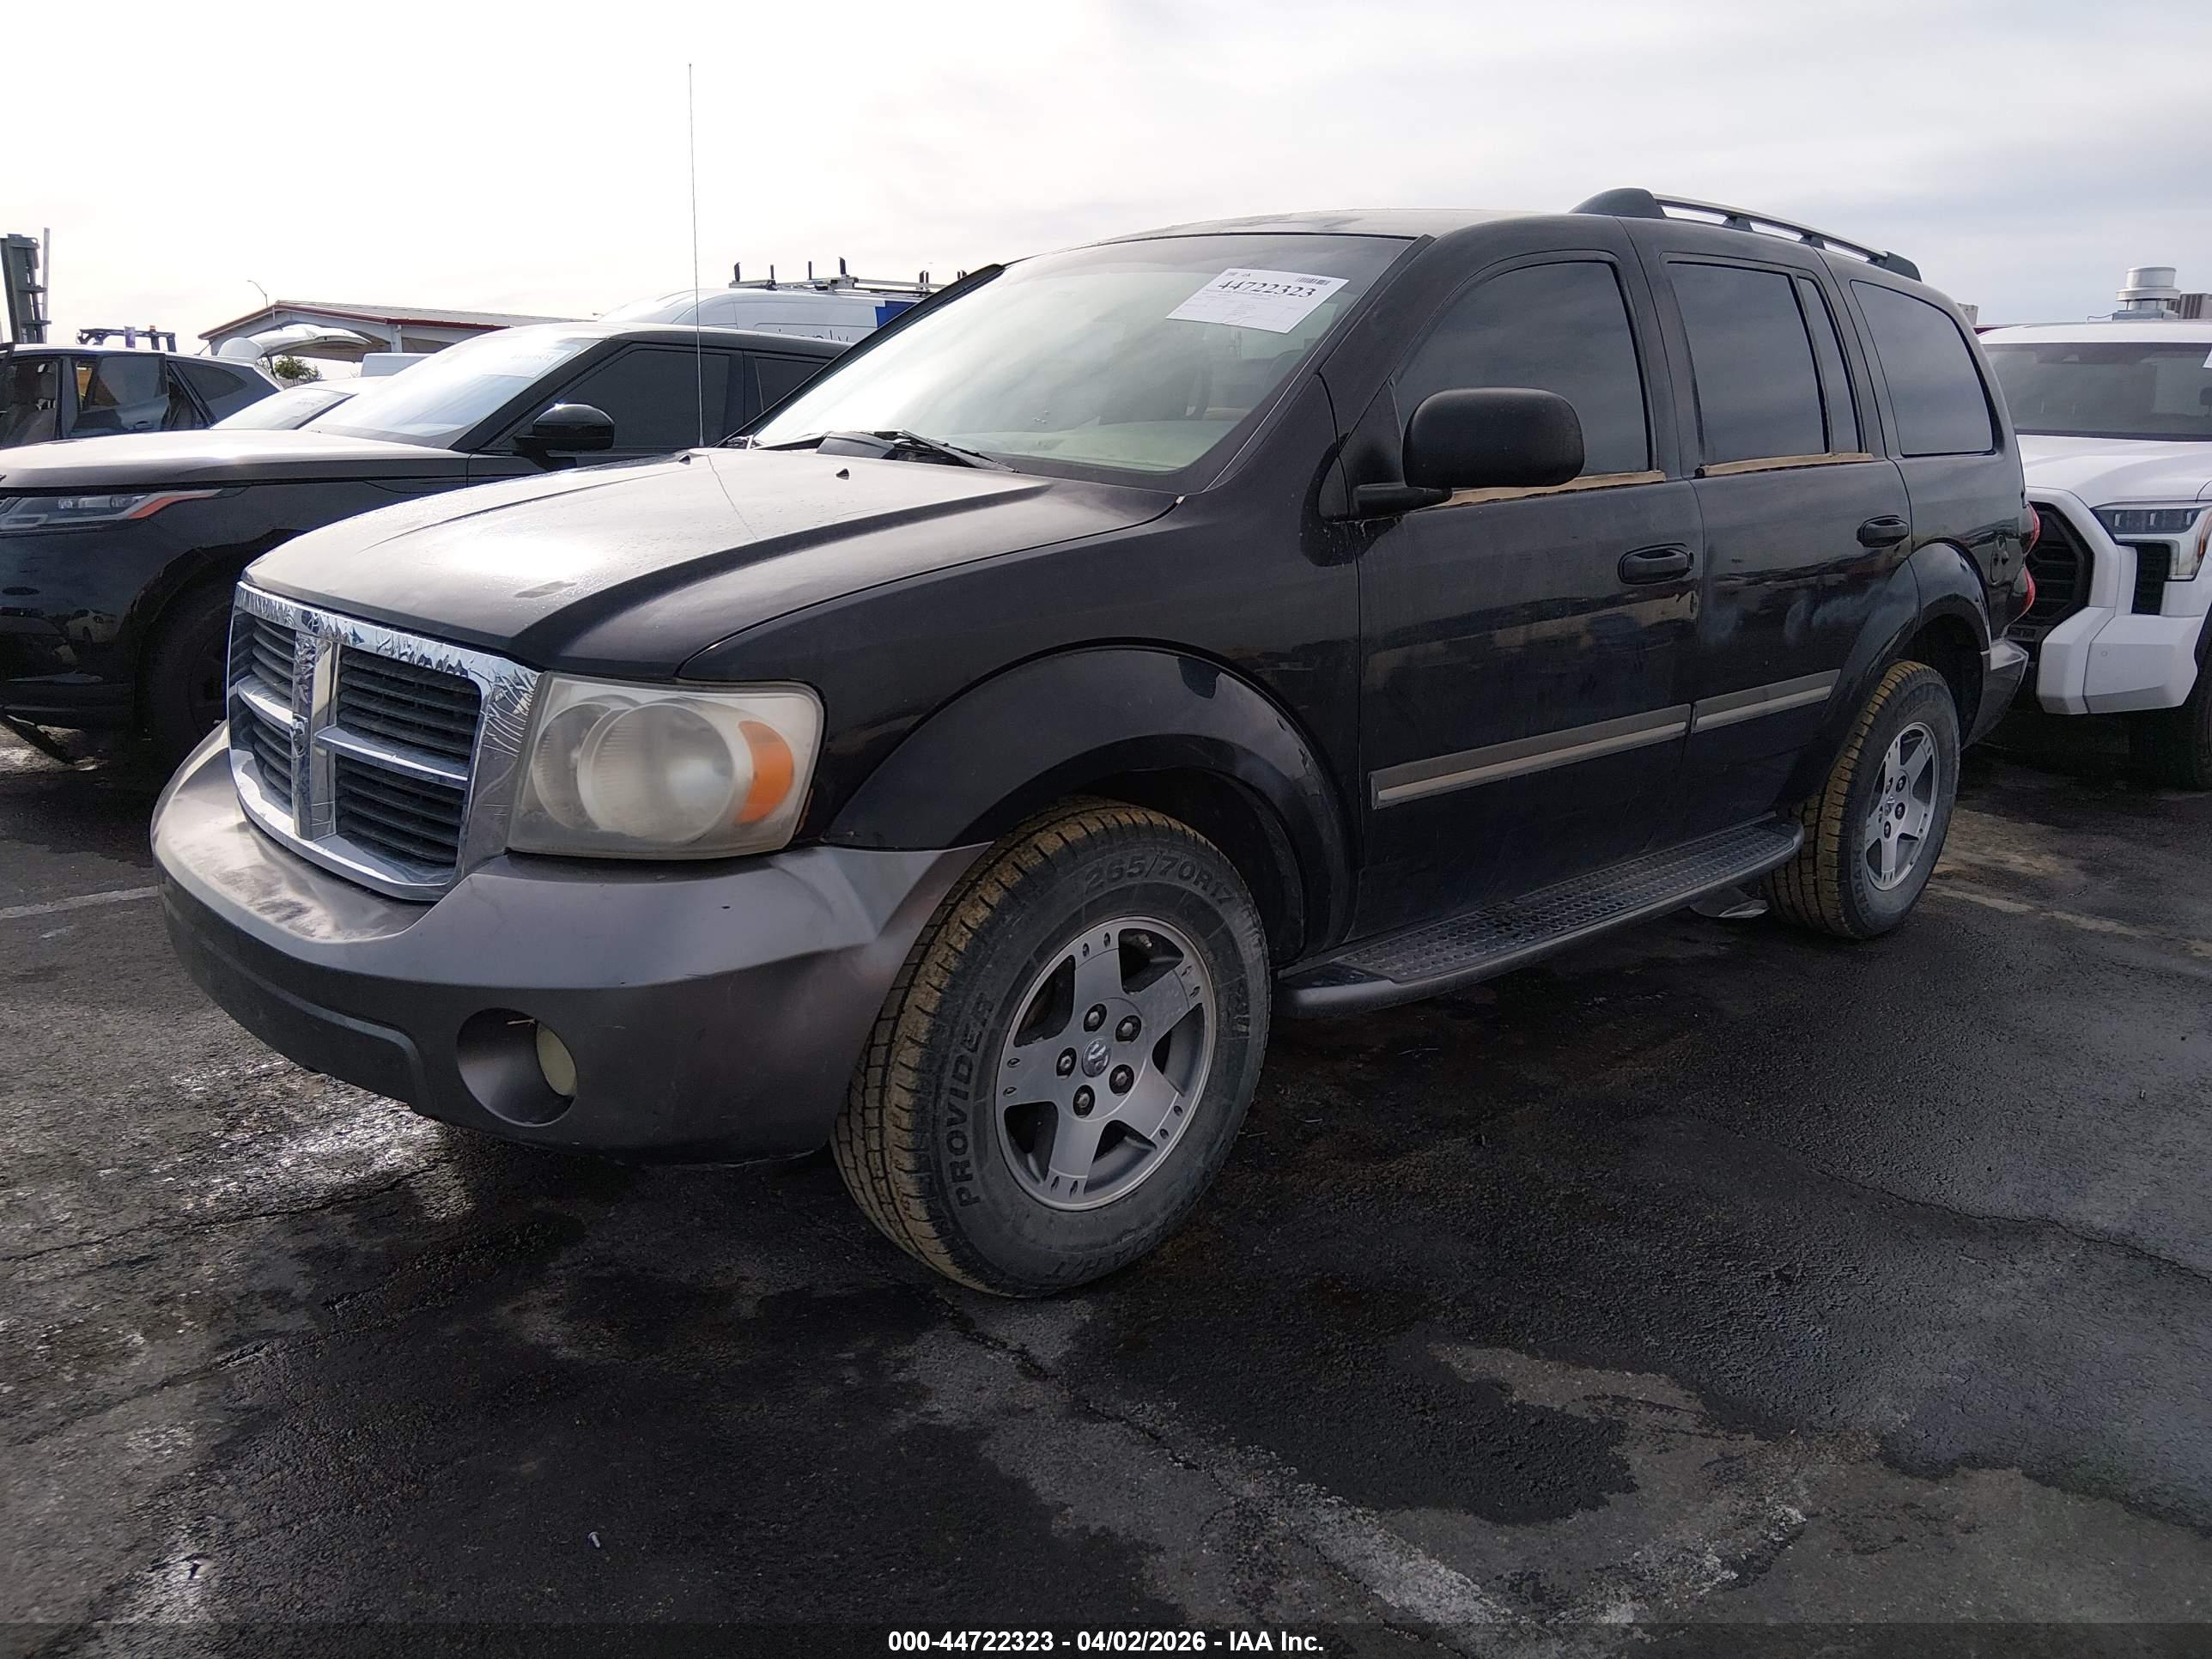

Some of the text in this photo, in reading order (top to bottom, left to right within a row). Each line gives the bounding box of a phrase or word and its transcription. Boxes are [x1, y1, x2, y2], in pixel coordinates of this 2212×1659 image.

[1218, 280, 1317, 298] 44722323
[1085, 852, 1233, 904] 265/70R17
[946, 992, 994, 1207] PROVIDER
